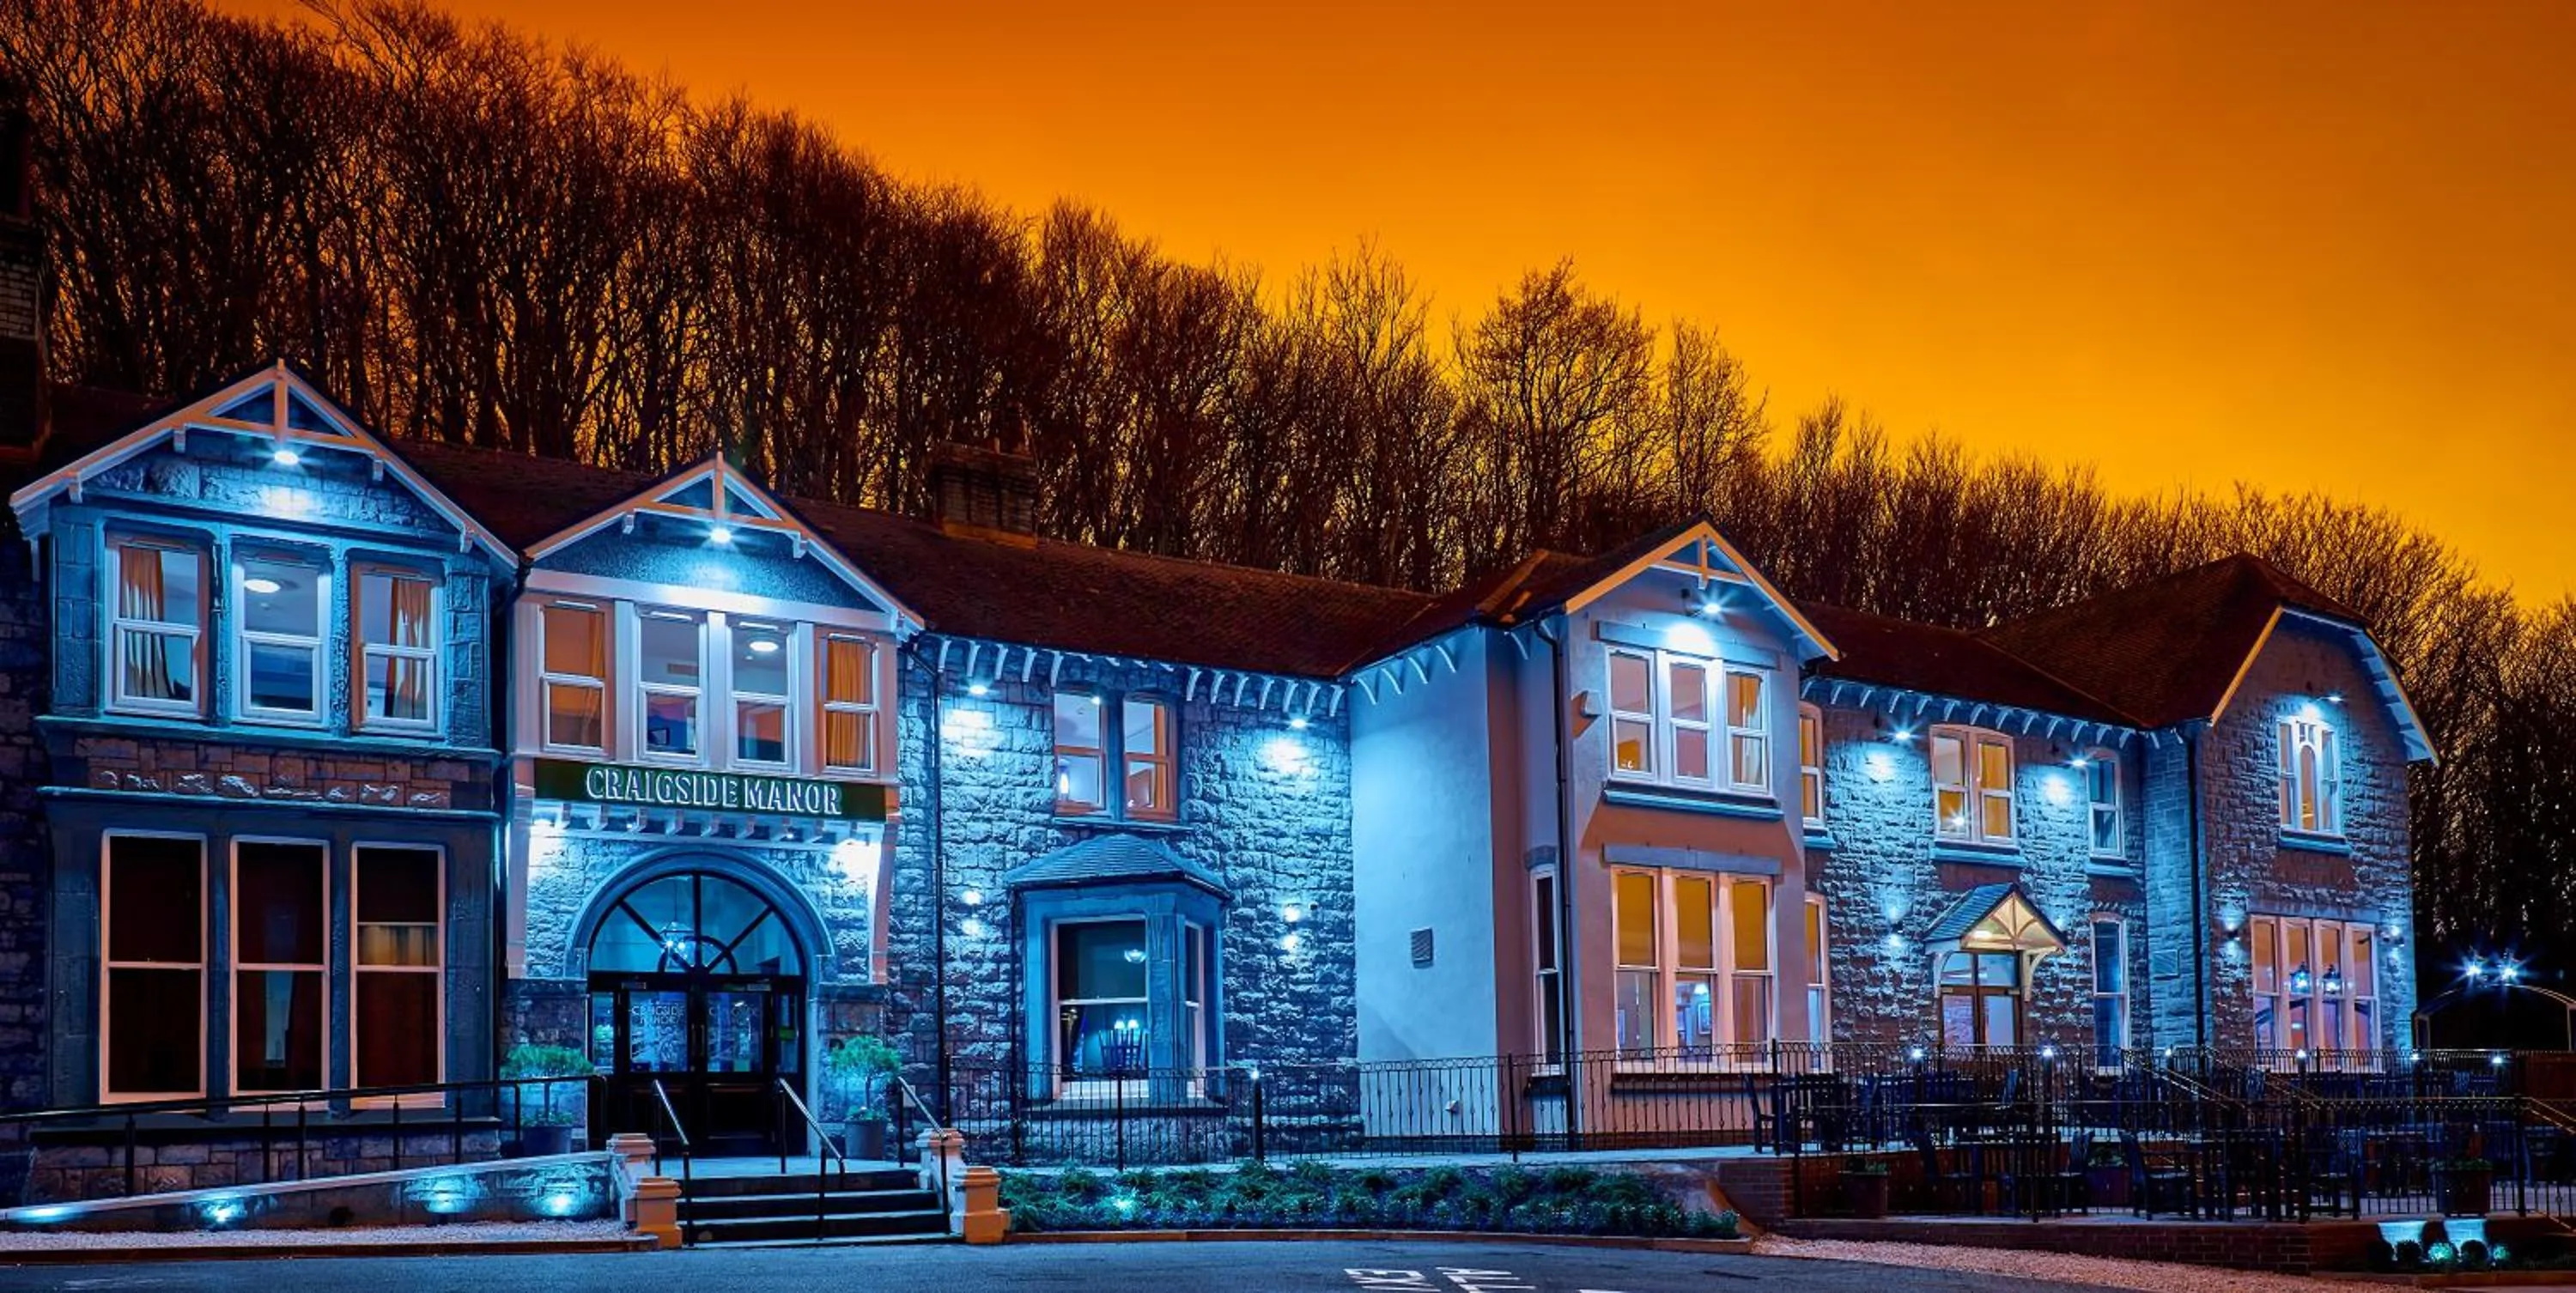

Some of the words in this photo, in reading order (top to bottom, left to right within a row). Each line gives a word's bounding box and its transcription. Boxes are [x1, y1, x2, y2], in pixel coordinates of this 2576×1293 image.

[586, 768, 738, 808] CRAIGSIDE
[744, 777, 842, 815] MANOR
[1344, 1268, 1441, 1292] EXI
